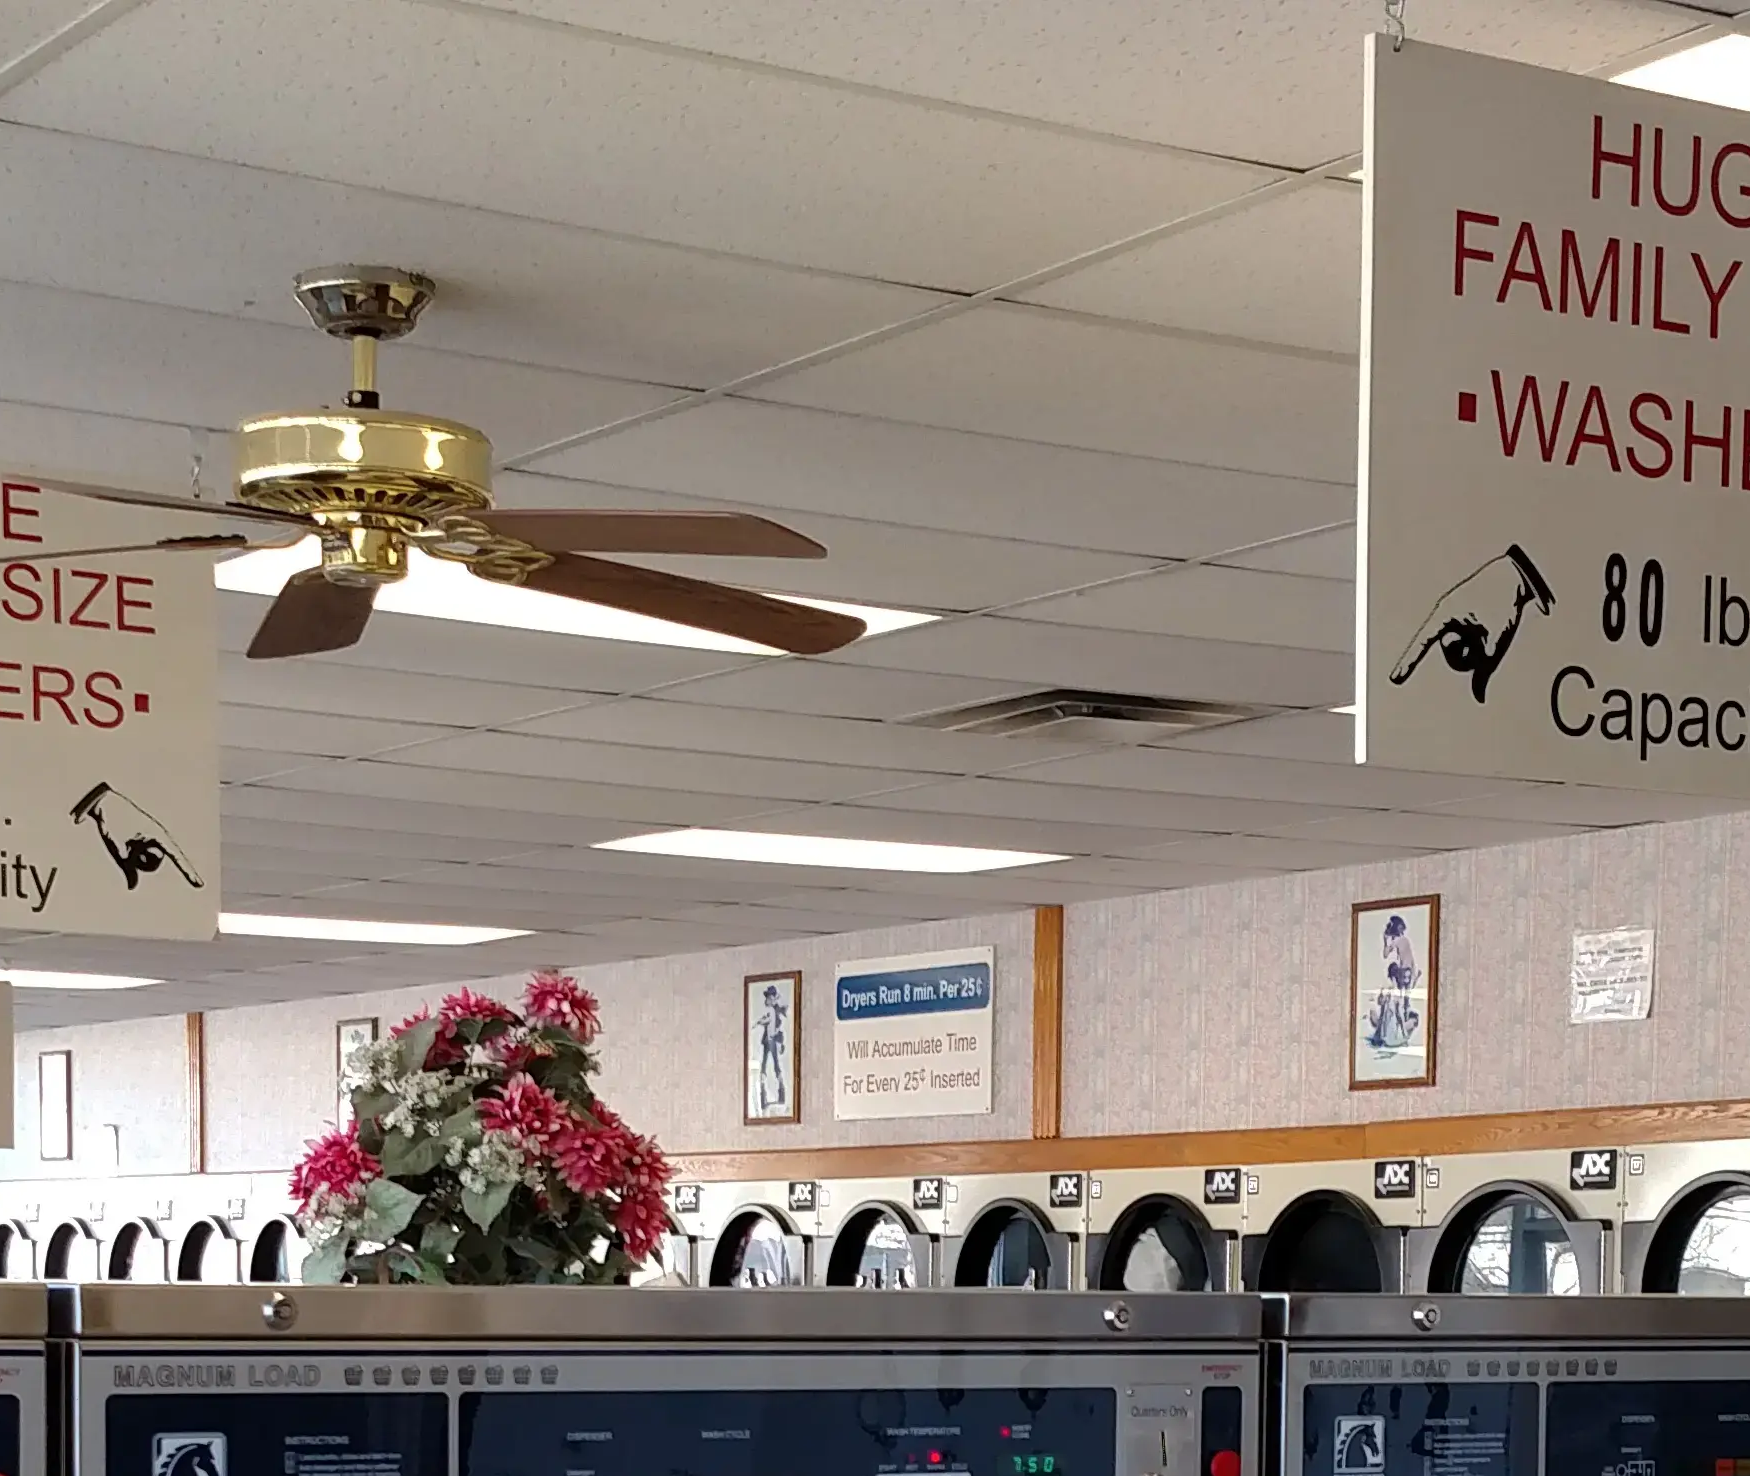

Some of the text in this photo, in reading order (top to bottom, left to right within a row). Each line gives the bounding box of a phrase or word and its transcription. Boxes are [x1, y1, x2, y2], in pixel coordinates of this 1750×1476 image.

[1453, 210, 1743, 340] FAMILY
[1, 563, 156, 635] SIZE
[1602, 553, 1664, 647] 80
[842, 989, 877, 1010] Dryers
[879, 985, 901, 1005] Run
[904, 984, 911, 1002] 8
[913, 983, 937, 1001] min.
[939, 979, 959, 999] Per
[847, 1032, 977, 1060] Will Accumulate Time
[843, 1075, 863, 1096] For
[866, 1073, 900, 1095] Every
[930, 1068, 980, 1089] Inserted
[1580, 1153, 1611, 1175] ADC
[114, 1364, 321, 1387] MAGNUM LOAD
[1310, 1359, 1451, 1378] MAGNUM LOAD
